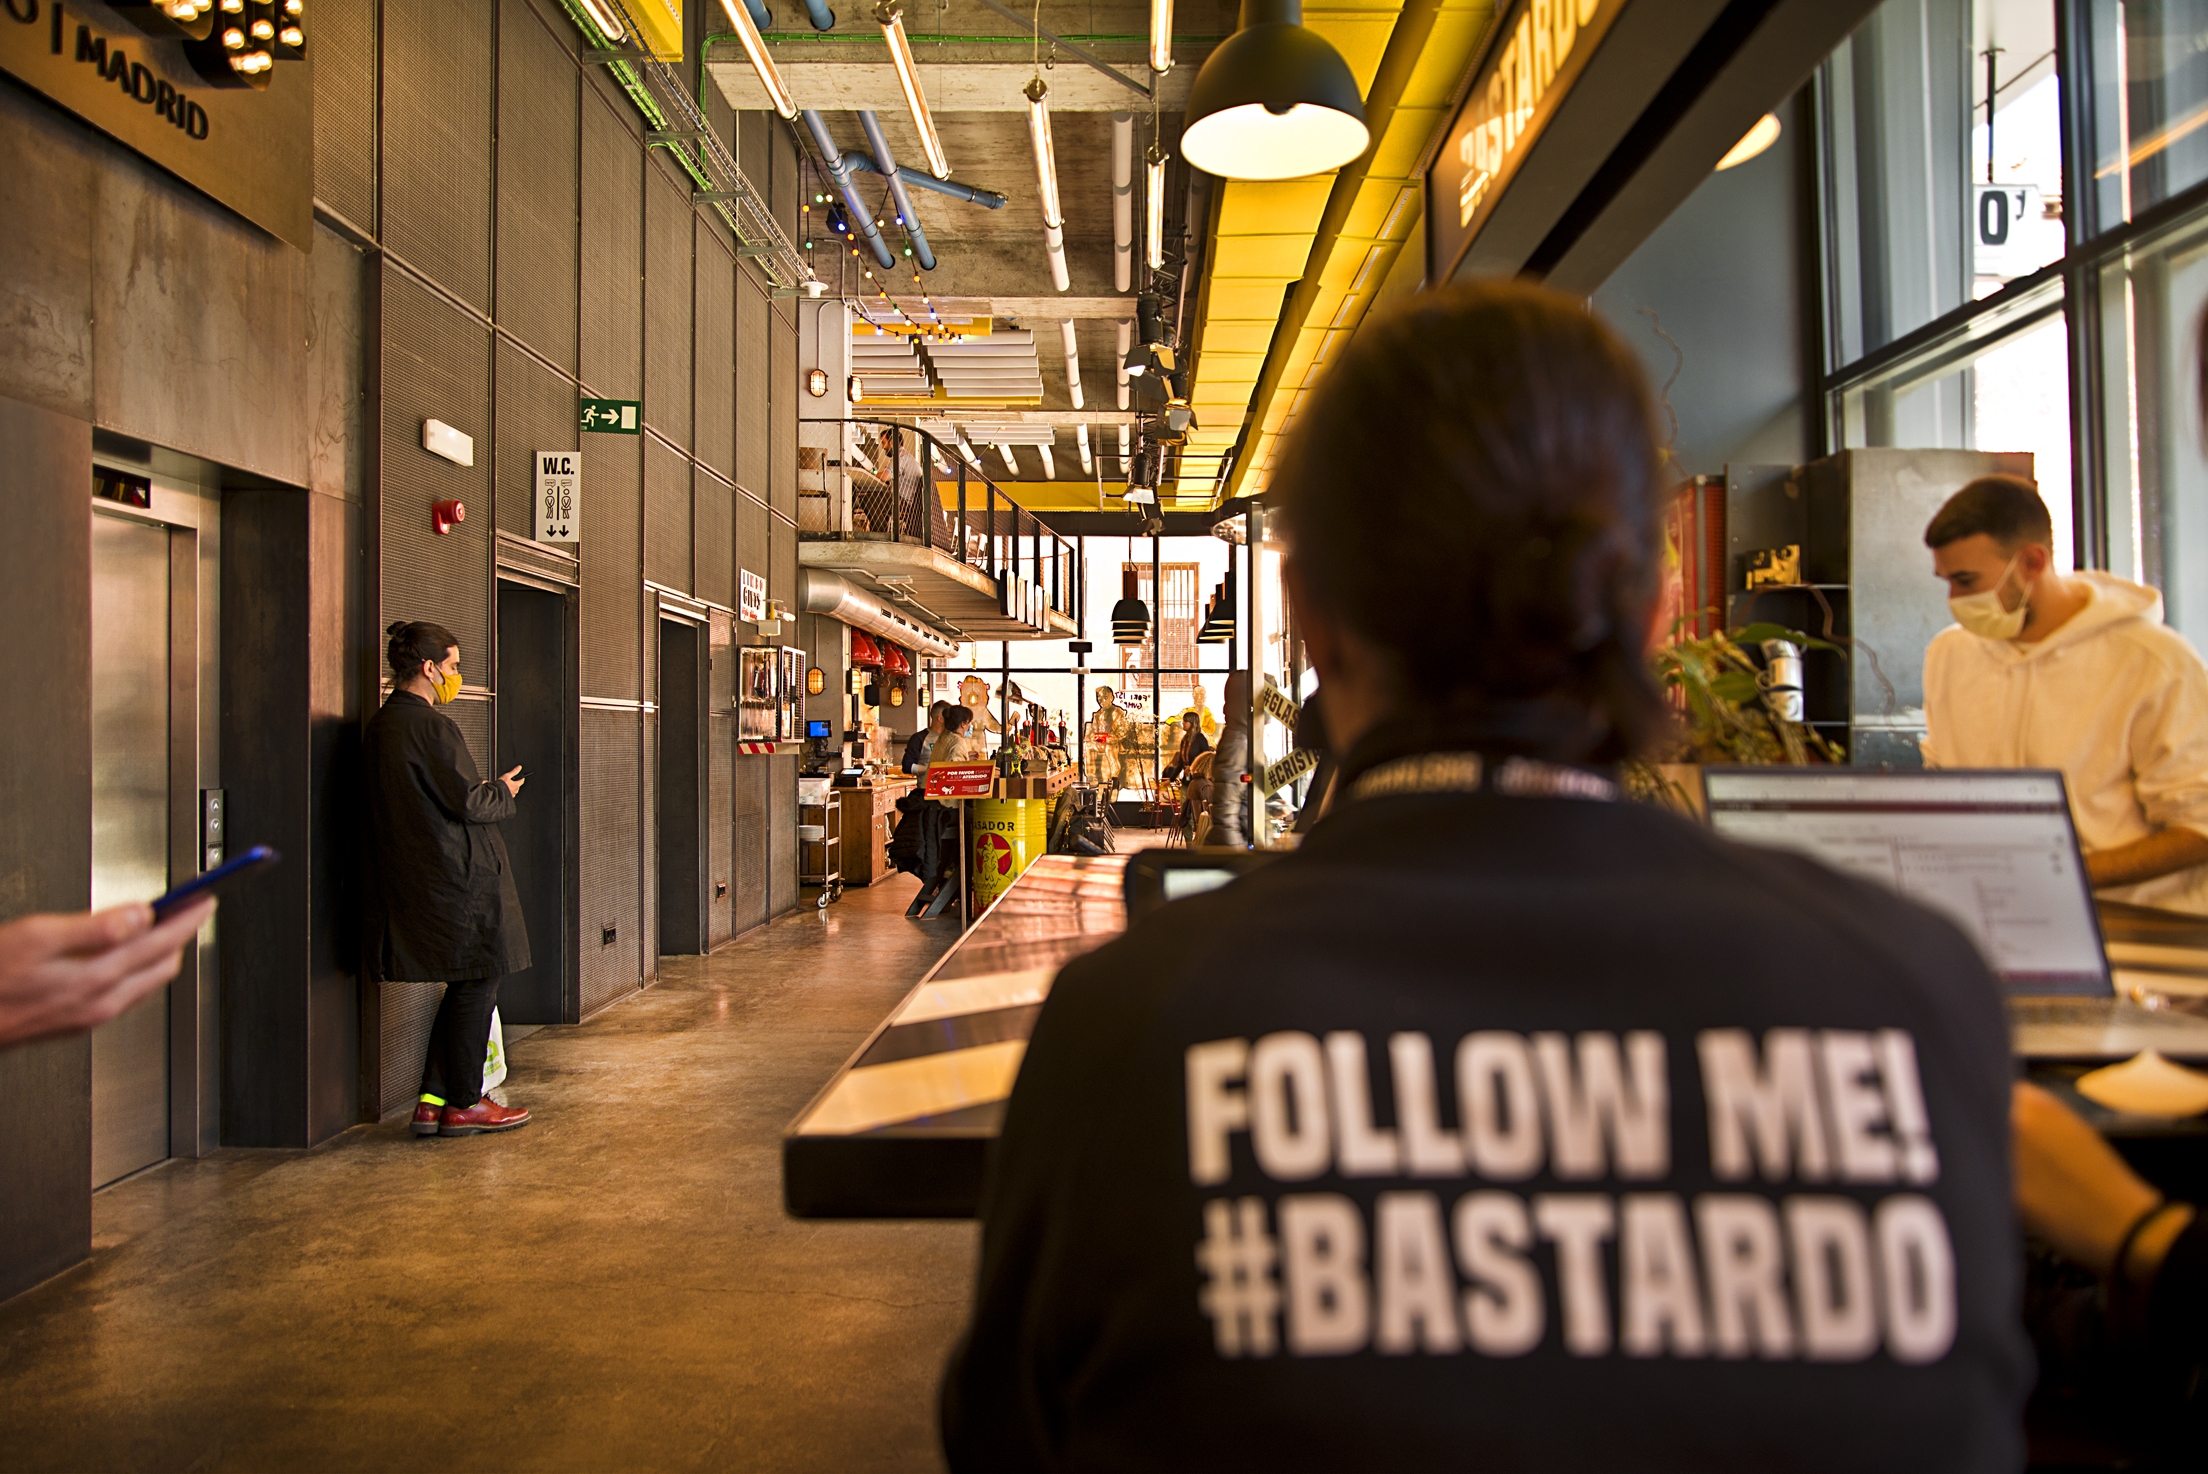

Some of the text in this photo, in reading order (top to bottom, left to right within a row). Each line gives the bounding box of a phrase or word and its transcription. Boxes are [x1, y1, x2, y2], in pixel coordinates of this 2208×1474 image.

[75, 24, 209, 140] MADRID
[1459, 0, 1600, 229] BASTARD
[543, 457, 575, 475] W.C.
[1185, 1027, 1940, 1186] FOLLOW ME!
[1197, 1190, 1958, 1366] #BASTARDO
